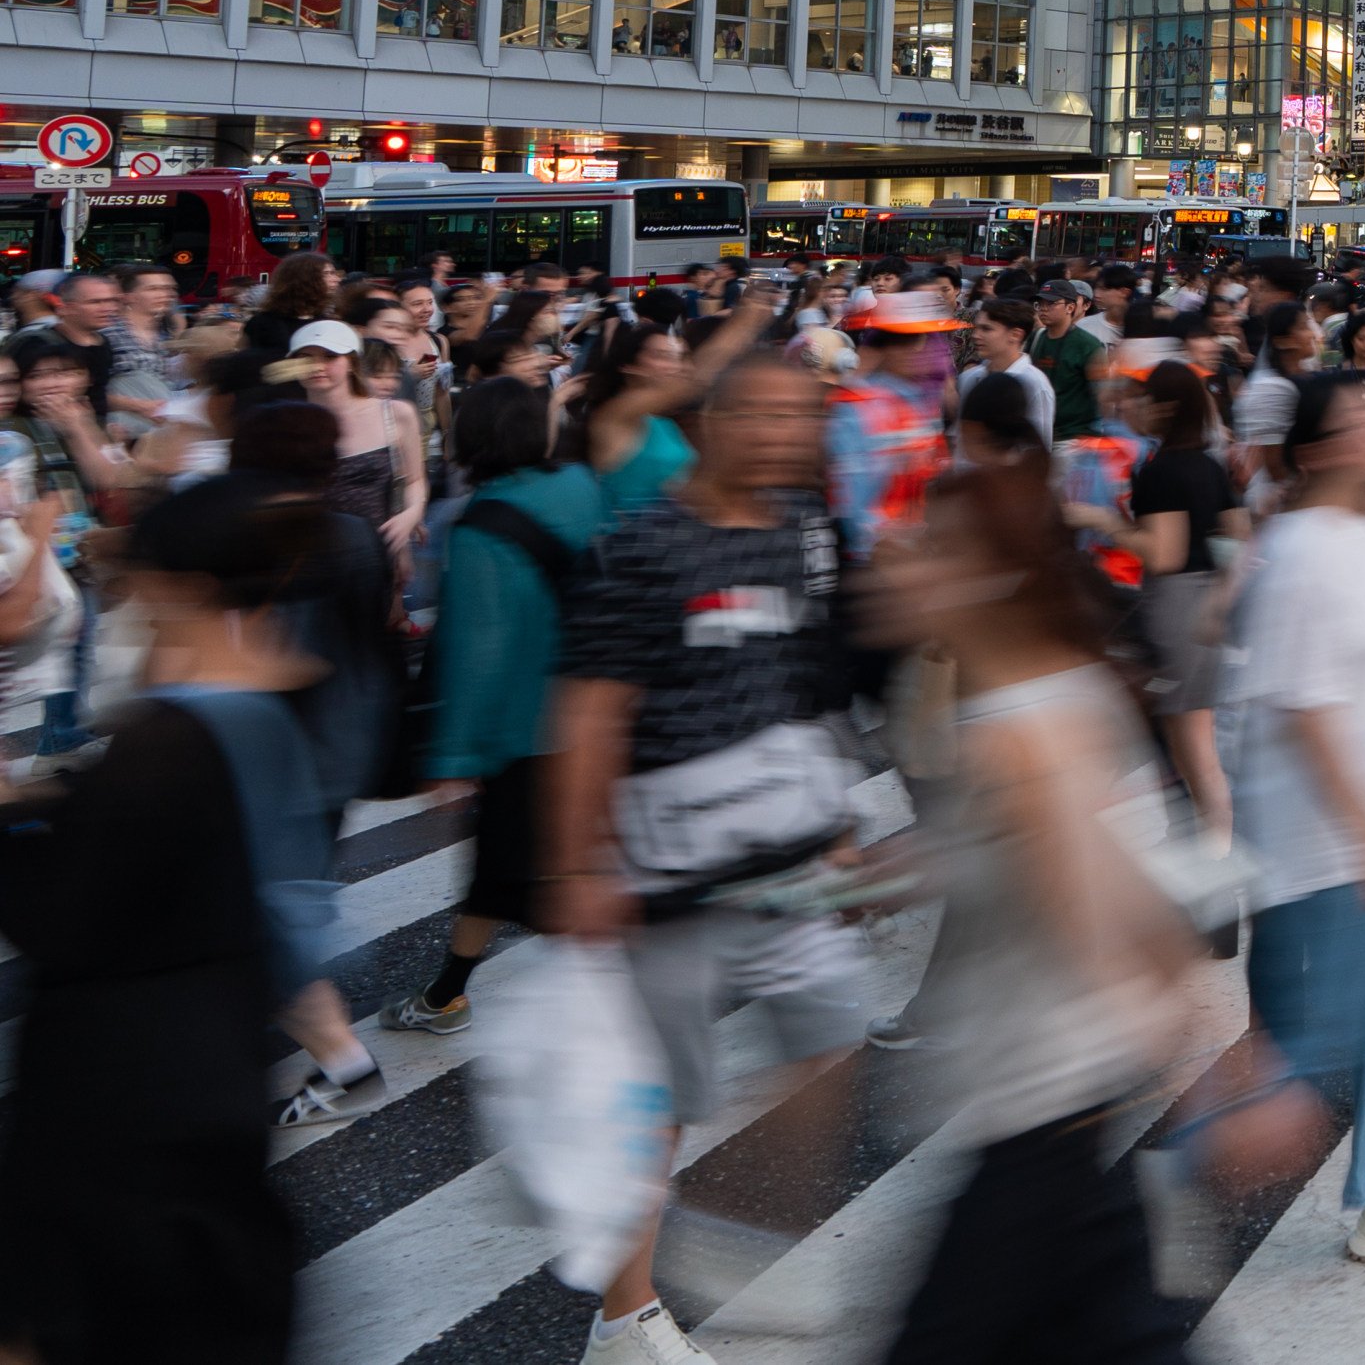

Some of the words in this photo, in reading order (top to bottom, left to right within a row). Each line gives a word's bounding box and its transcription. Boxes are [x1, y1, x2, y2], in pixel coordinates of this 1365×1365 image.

[40, 172, 105, 185] ここまで
[137, 194, 167, 206] BUS
[643, 224, 681, 233] Hybrid
